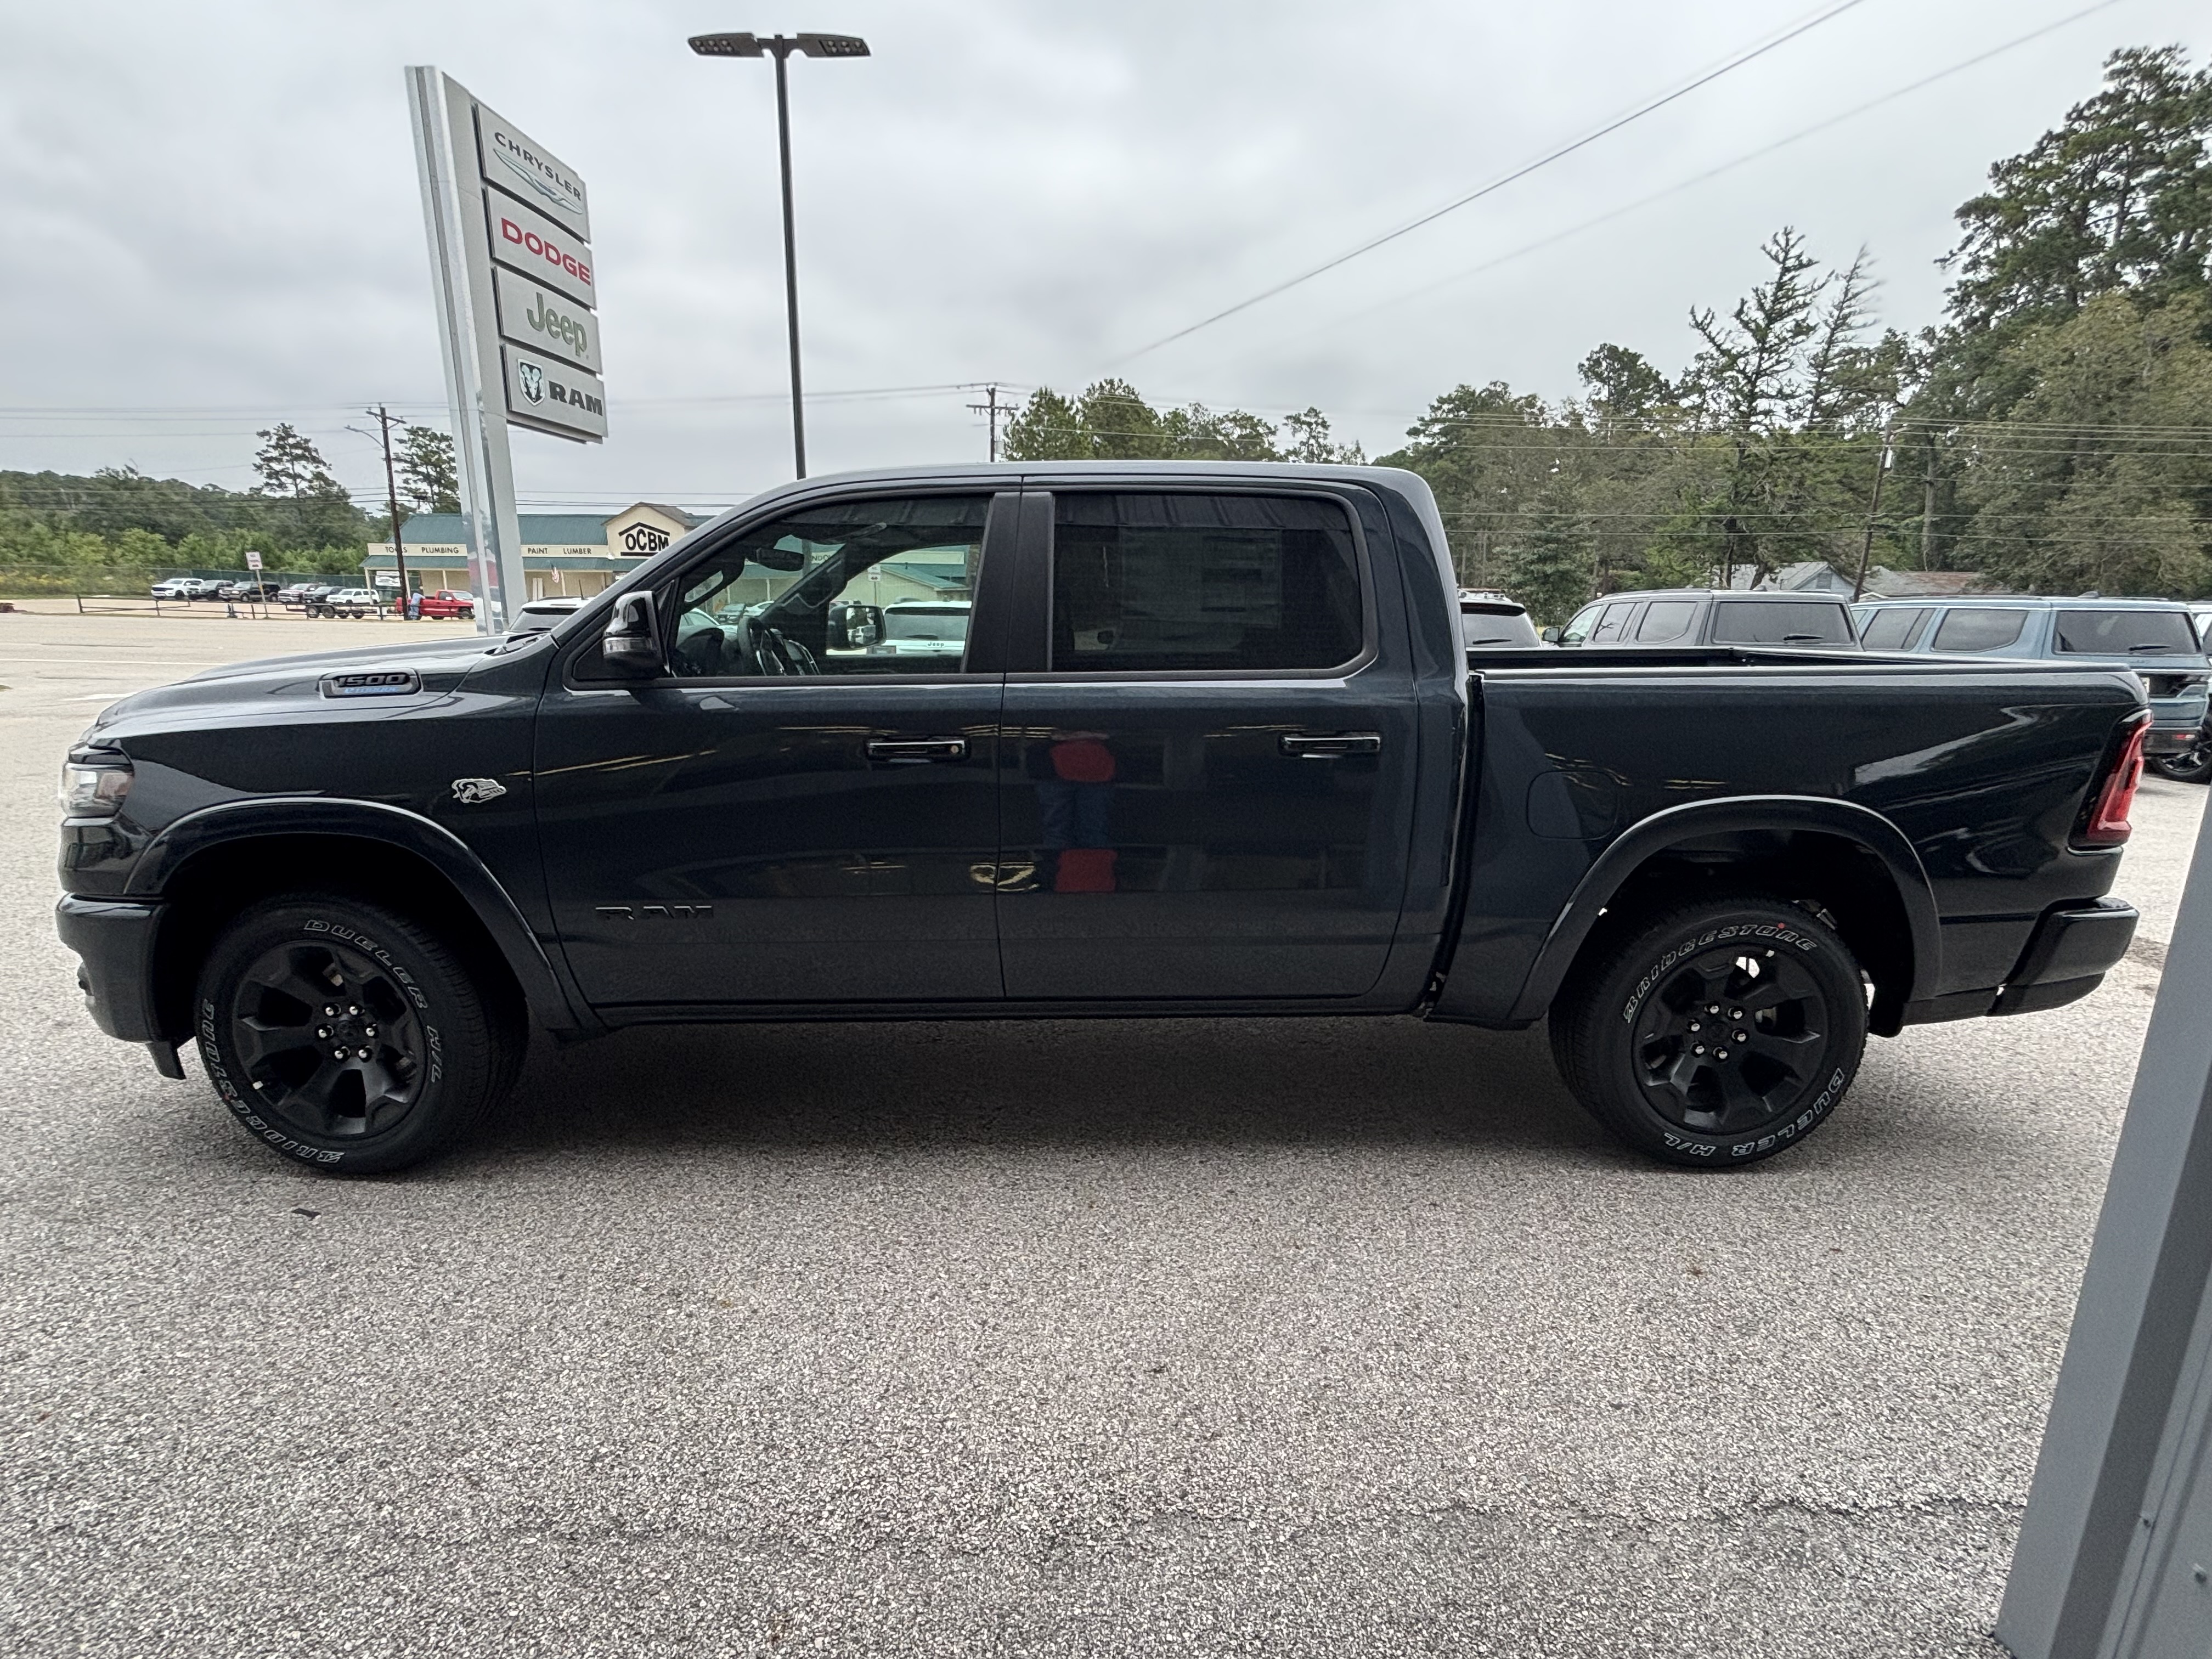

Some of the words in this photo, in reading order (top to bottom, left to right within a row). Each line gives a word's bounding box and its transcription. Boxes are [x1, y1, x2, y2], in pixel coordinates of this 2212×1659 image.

[495, 132, 582, 201] CHRYSLER
[500, 217, 591, 286] DODGE
[527, 292, 588, 357] Jeep
[548, 380, 603, 416] RAM
[625, 528, 669, 551] OCBM
[335, 674, 407, 686] 1500
[304, 919, 428, 1008] DUELER
[427, 1024, 442, 1083] H/L
[1623, 924, 1817, 1023] BRIDGESTONE
[201, 998, 345, 1163] BRIDGESTONE
[1731, 1068, 1845, 1156] DUELER
[1664, 1132, 1716, 1156] H/L
